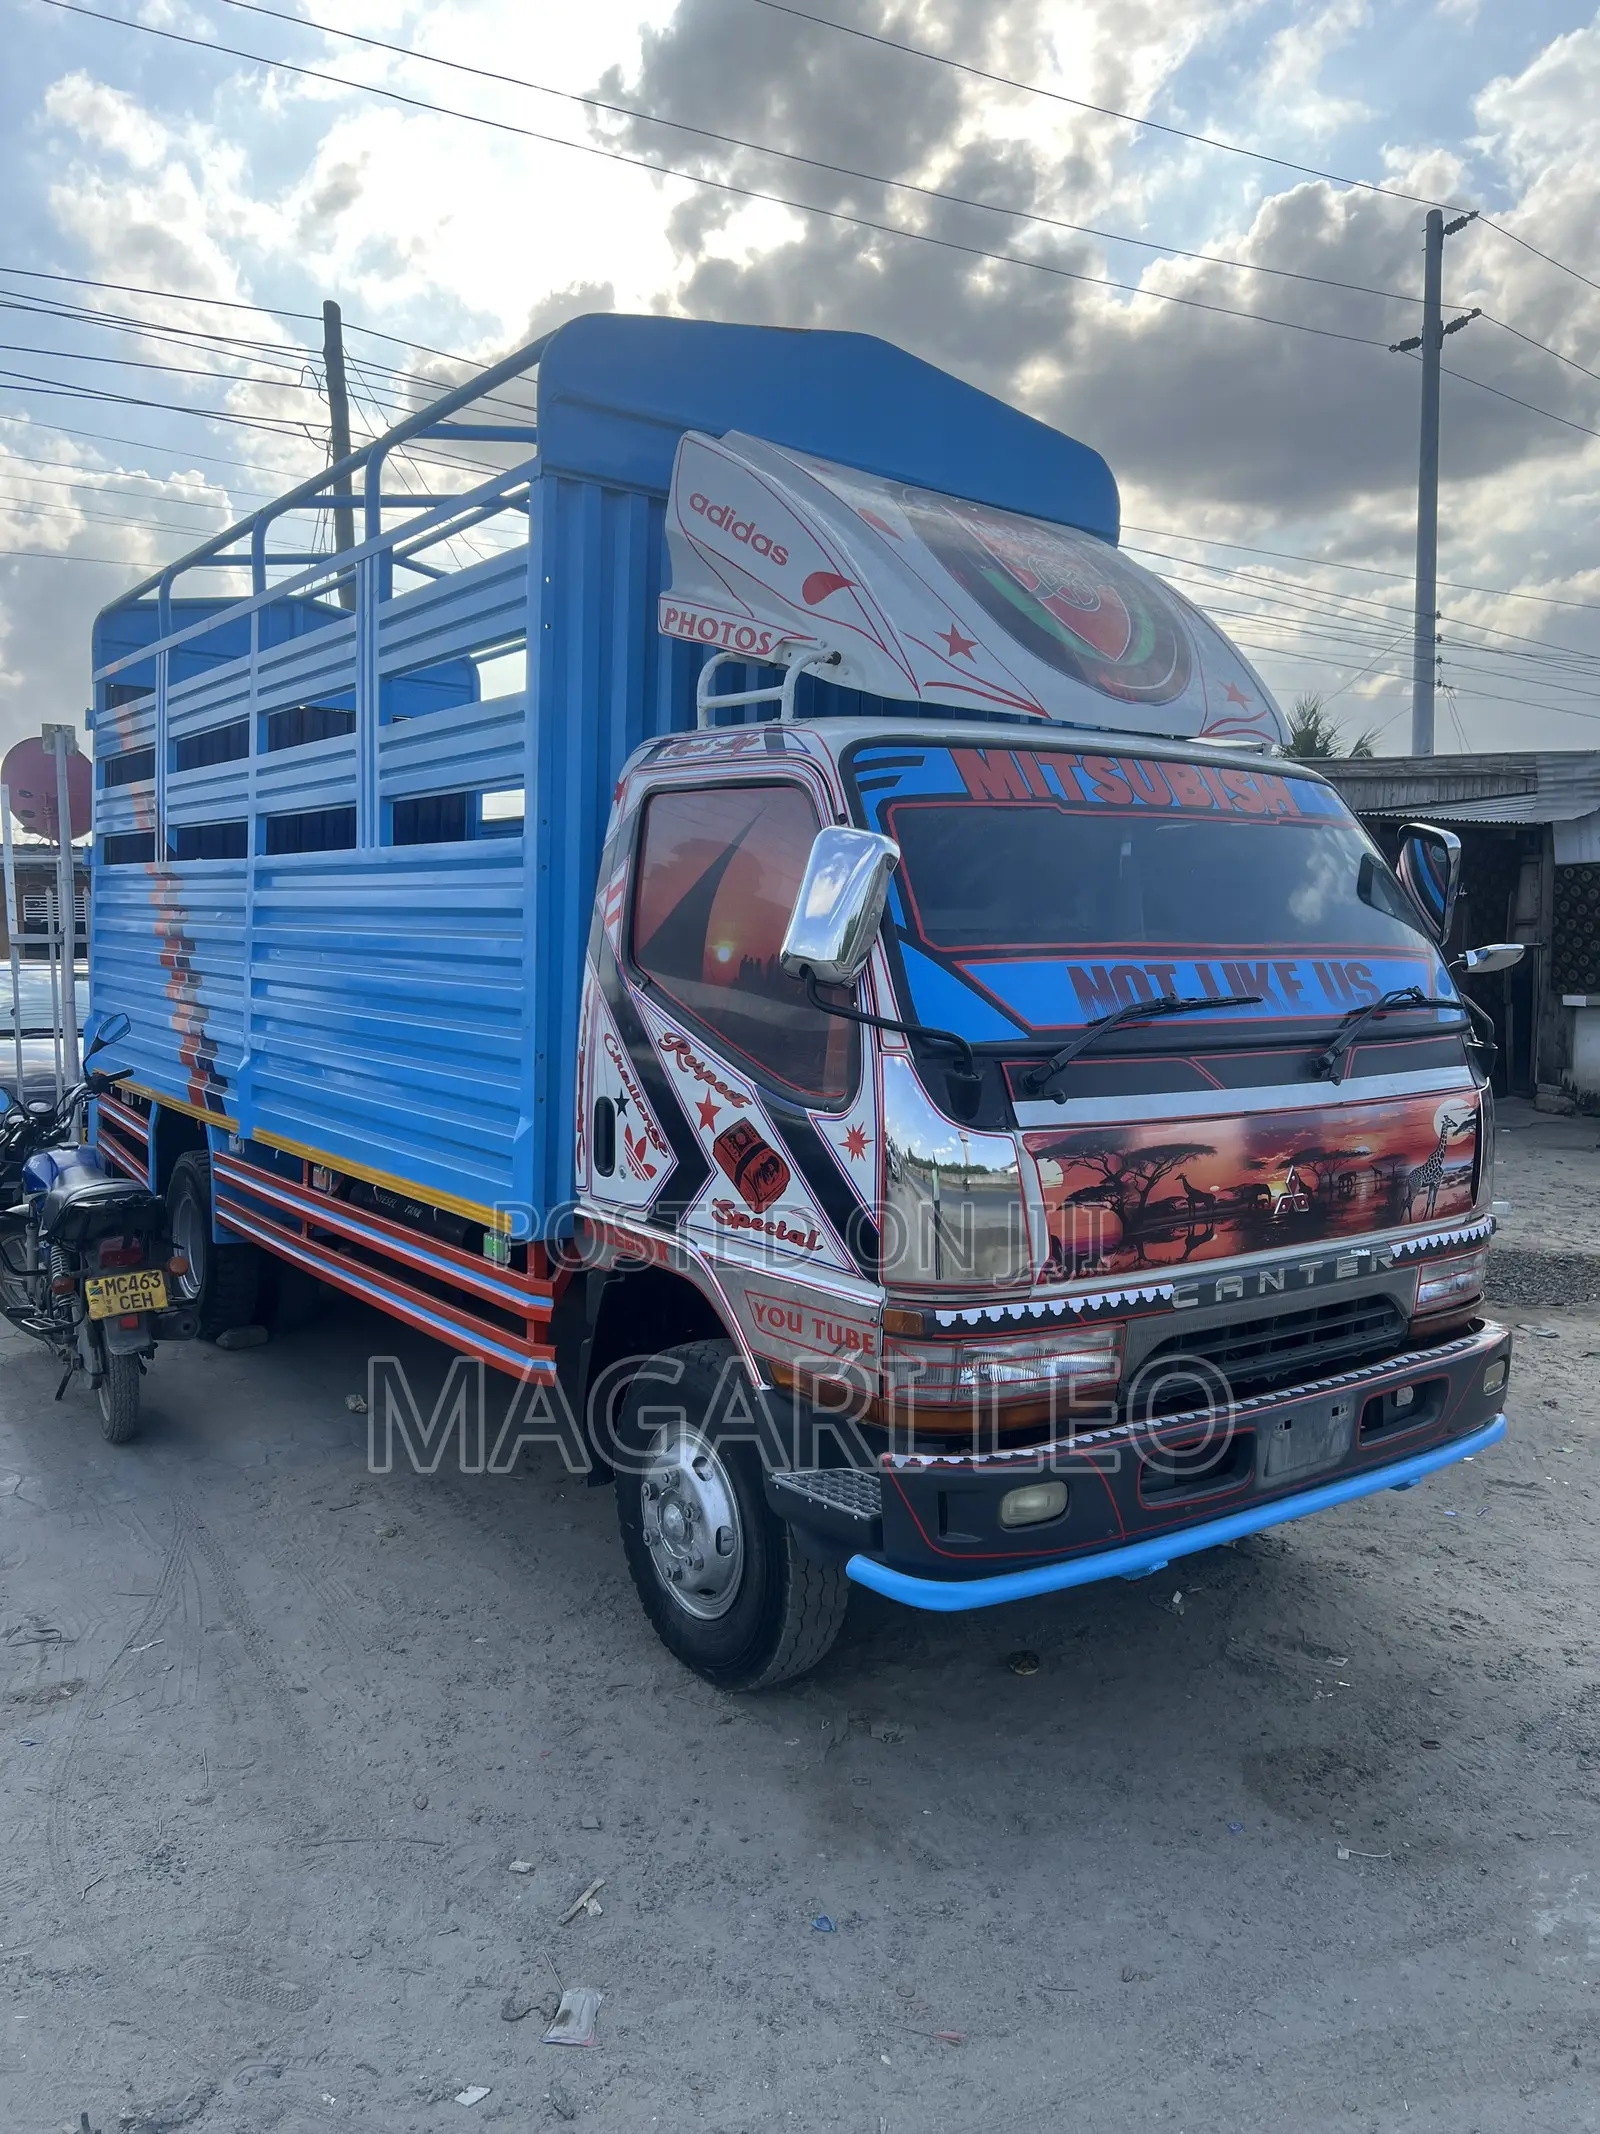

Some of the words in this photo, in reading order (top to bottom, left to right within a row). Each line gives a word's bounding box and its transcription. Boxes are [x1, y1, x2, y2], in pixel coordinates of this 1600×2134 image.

[690, 493, 789, 566] adidas
[664, 608, 772, 654] PHOTOS
[950, 749, 1302, 817] MITSUBISH
[1066, 965, 1177, 1022] NOT
[1195, 962, 1313, 1013] LIKE
[1311, 961, 1383, 1010] US
[604, 1033, 668, 1158] Challenge
[658, 1032, 753, 1108] Respect
[712, 1199, 824, 1250] Special
[105, 1272, 161, 1296] MC463
[119, 1292, 154, 1309] CEH
[1172, 1250, 1394, 1309] CANTER
[753, 1302, 802, 1334] YOU
[811, 1318, 876, 1355] TUBE
